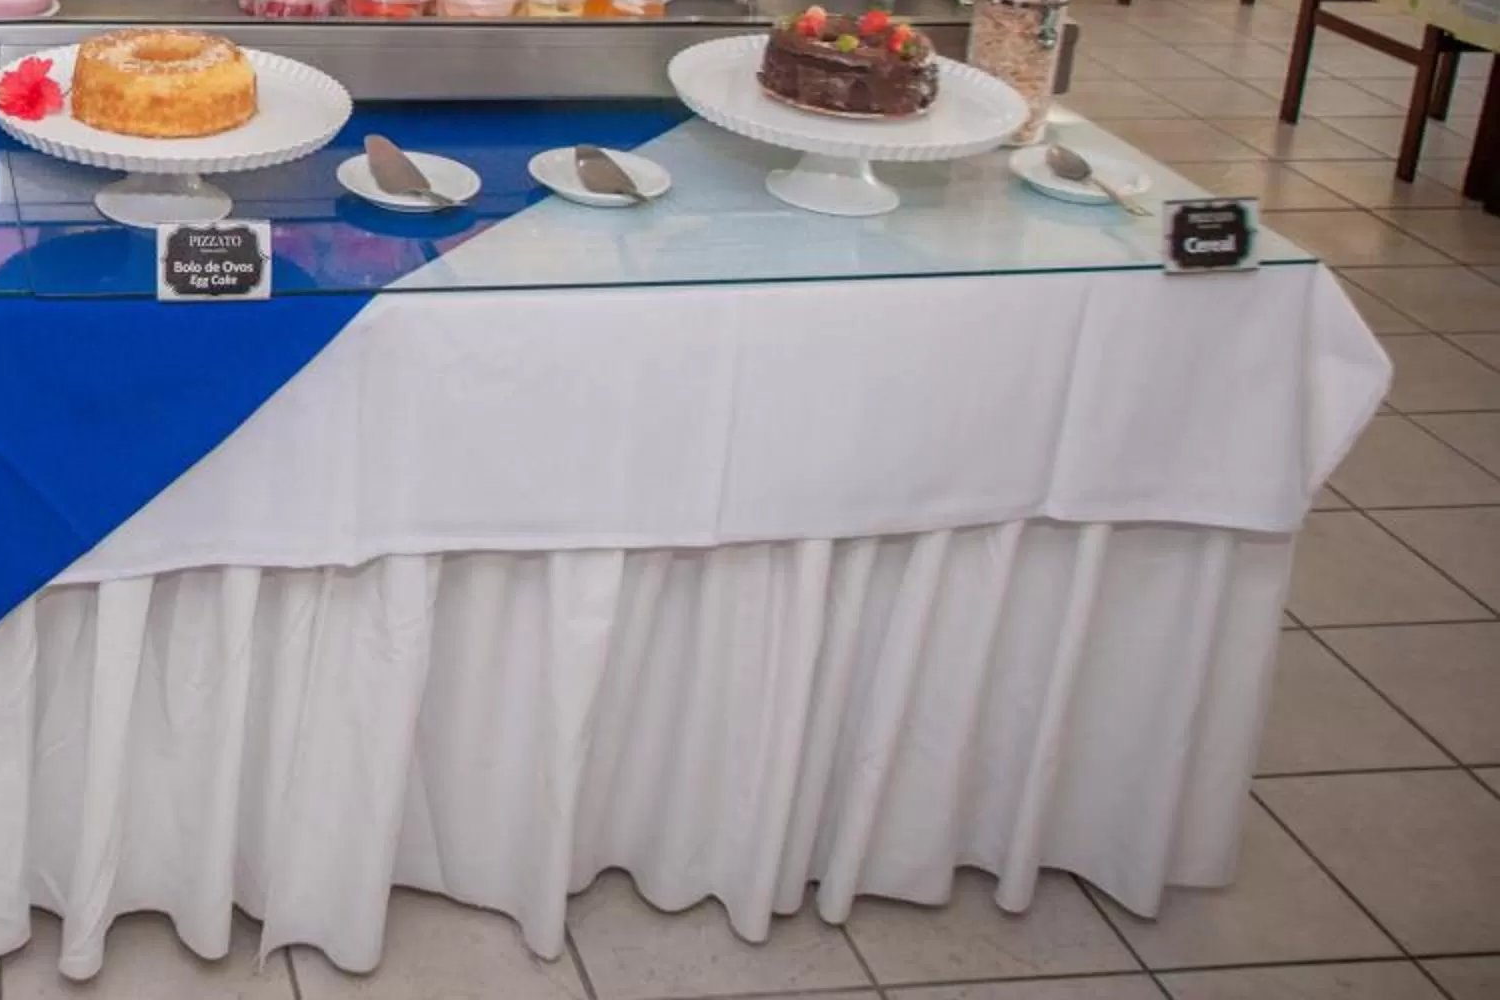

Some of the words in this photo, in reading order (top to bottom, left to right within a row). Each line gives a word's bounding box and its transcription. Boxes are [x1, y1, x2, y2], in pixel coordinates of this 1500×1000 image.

[188, 235, 242, 248] PIZZATO
[173, 261, 202, 273] Bolo
[204, 261, 220, 273] de
[222, 261, 254, 273] Ovos
